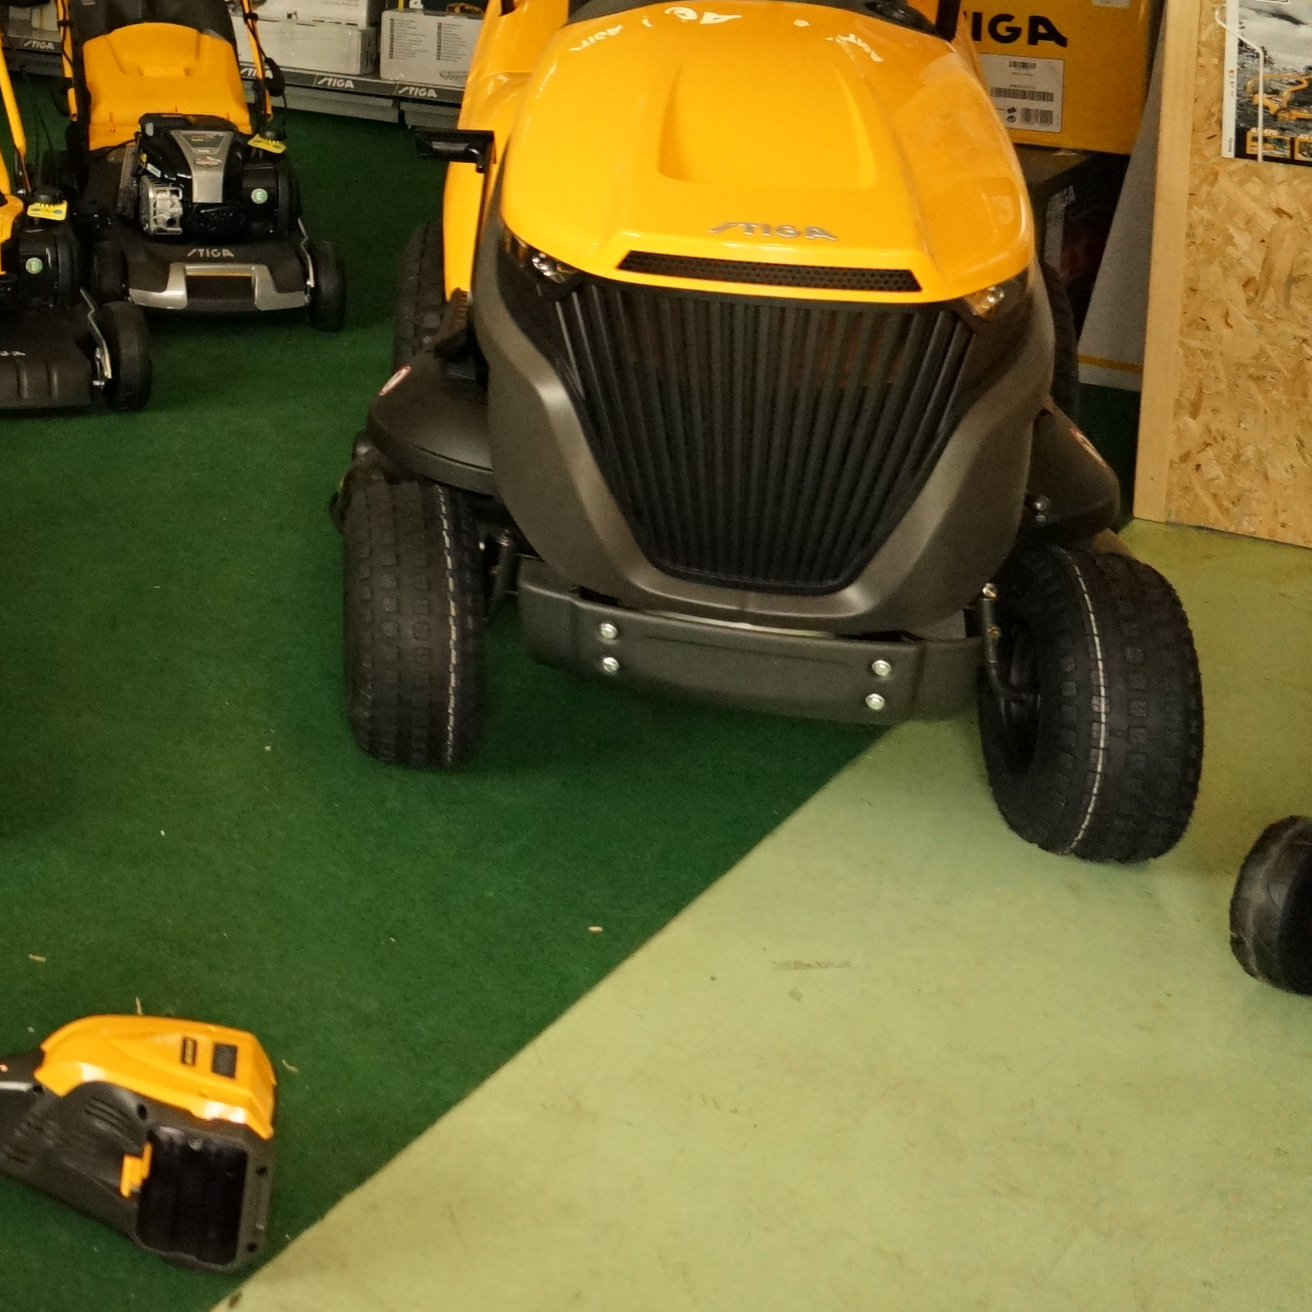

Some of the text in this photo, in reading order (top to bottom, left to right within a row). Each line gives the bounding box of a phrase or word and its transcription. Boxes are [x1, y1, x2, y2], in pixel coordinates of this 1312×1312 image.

[964, 10, 1068, 48] IGA
[23, 40, 55, 51] STIGA
[318, 77, 355, 89] STIGA
[399, 86, 438, 99] STIGA
[708, 221, 838, 241] STIGA
[187, 248, 235, 258] STIGA
